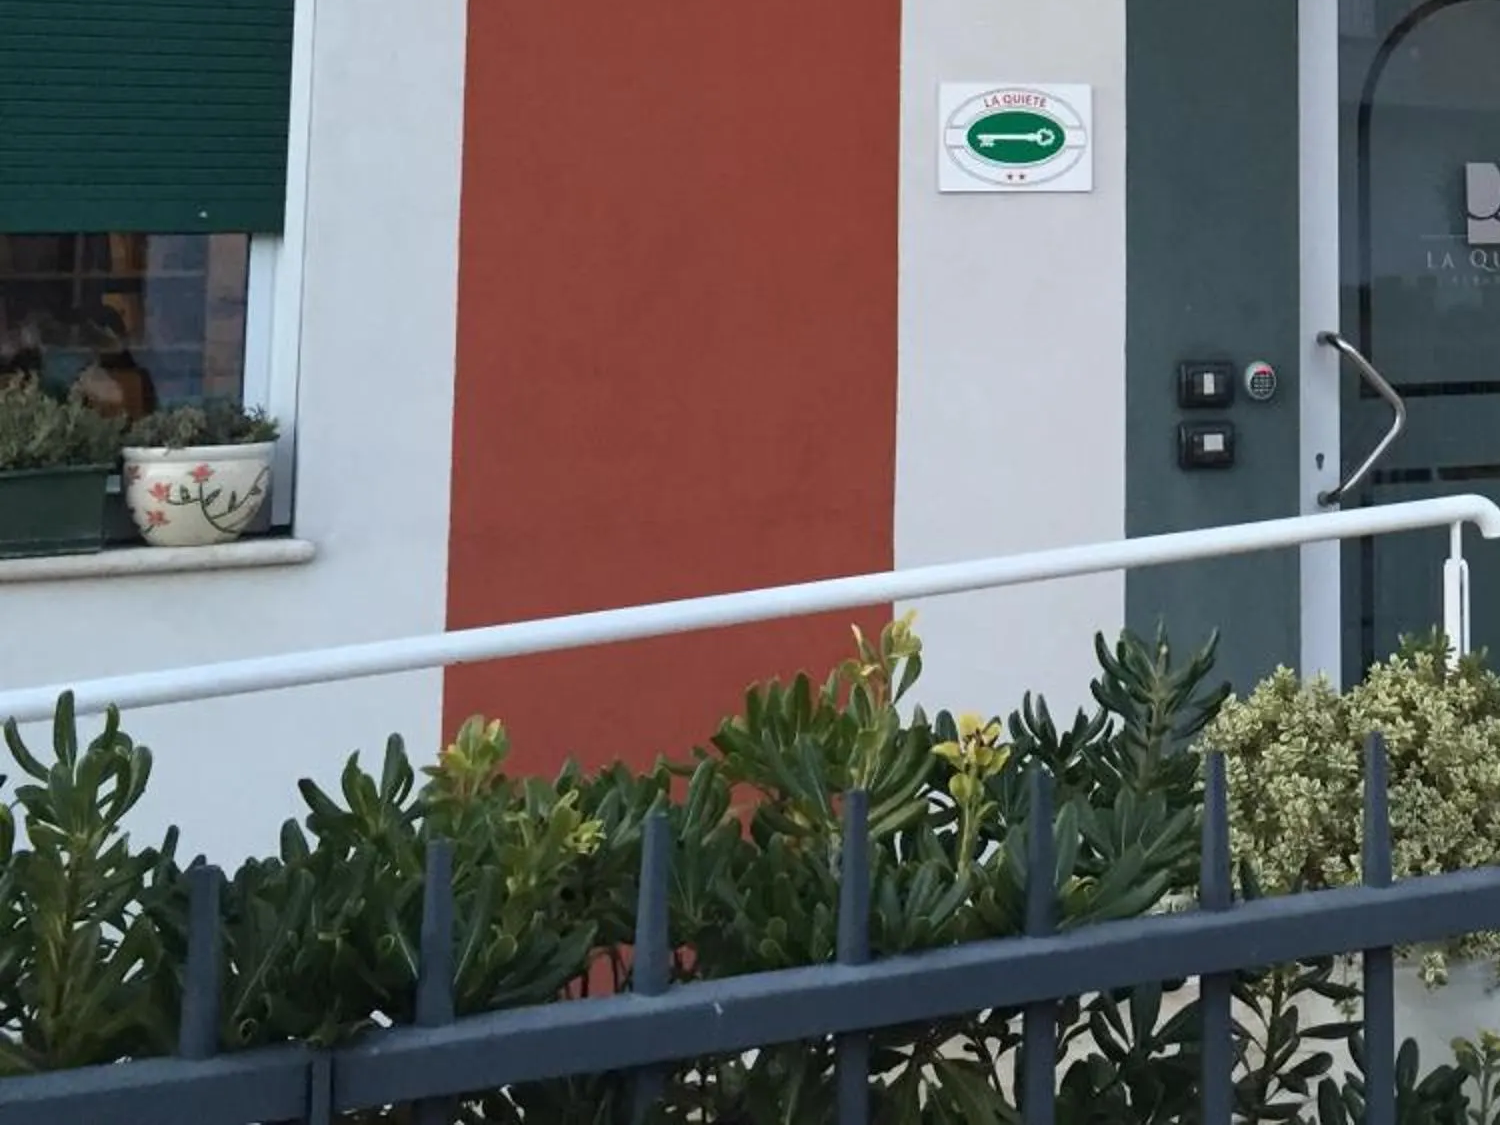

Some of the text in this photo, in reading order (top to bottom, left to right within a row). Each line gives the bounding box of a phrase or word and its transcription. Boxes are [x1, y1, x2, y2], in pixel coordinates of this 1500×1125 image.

[985, 94, 1048, 108] LA QUIETE
[1426, 250, 1455, 269] LA
